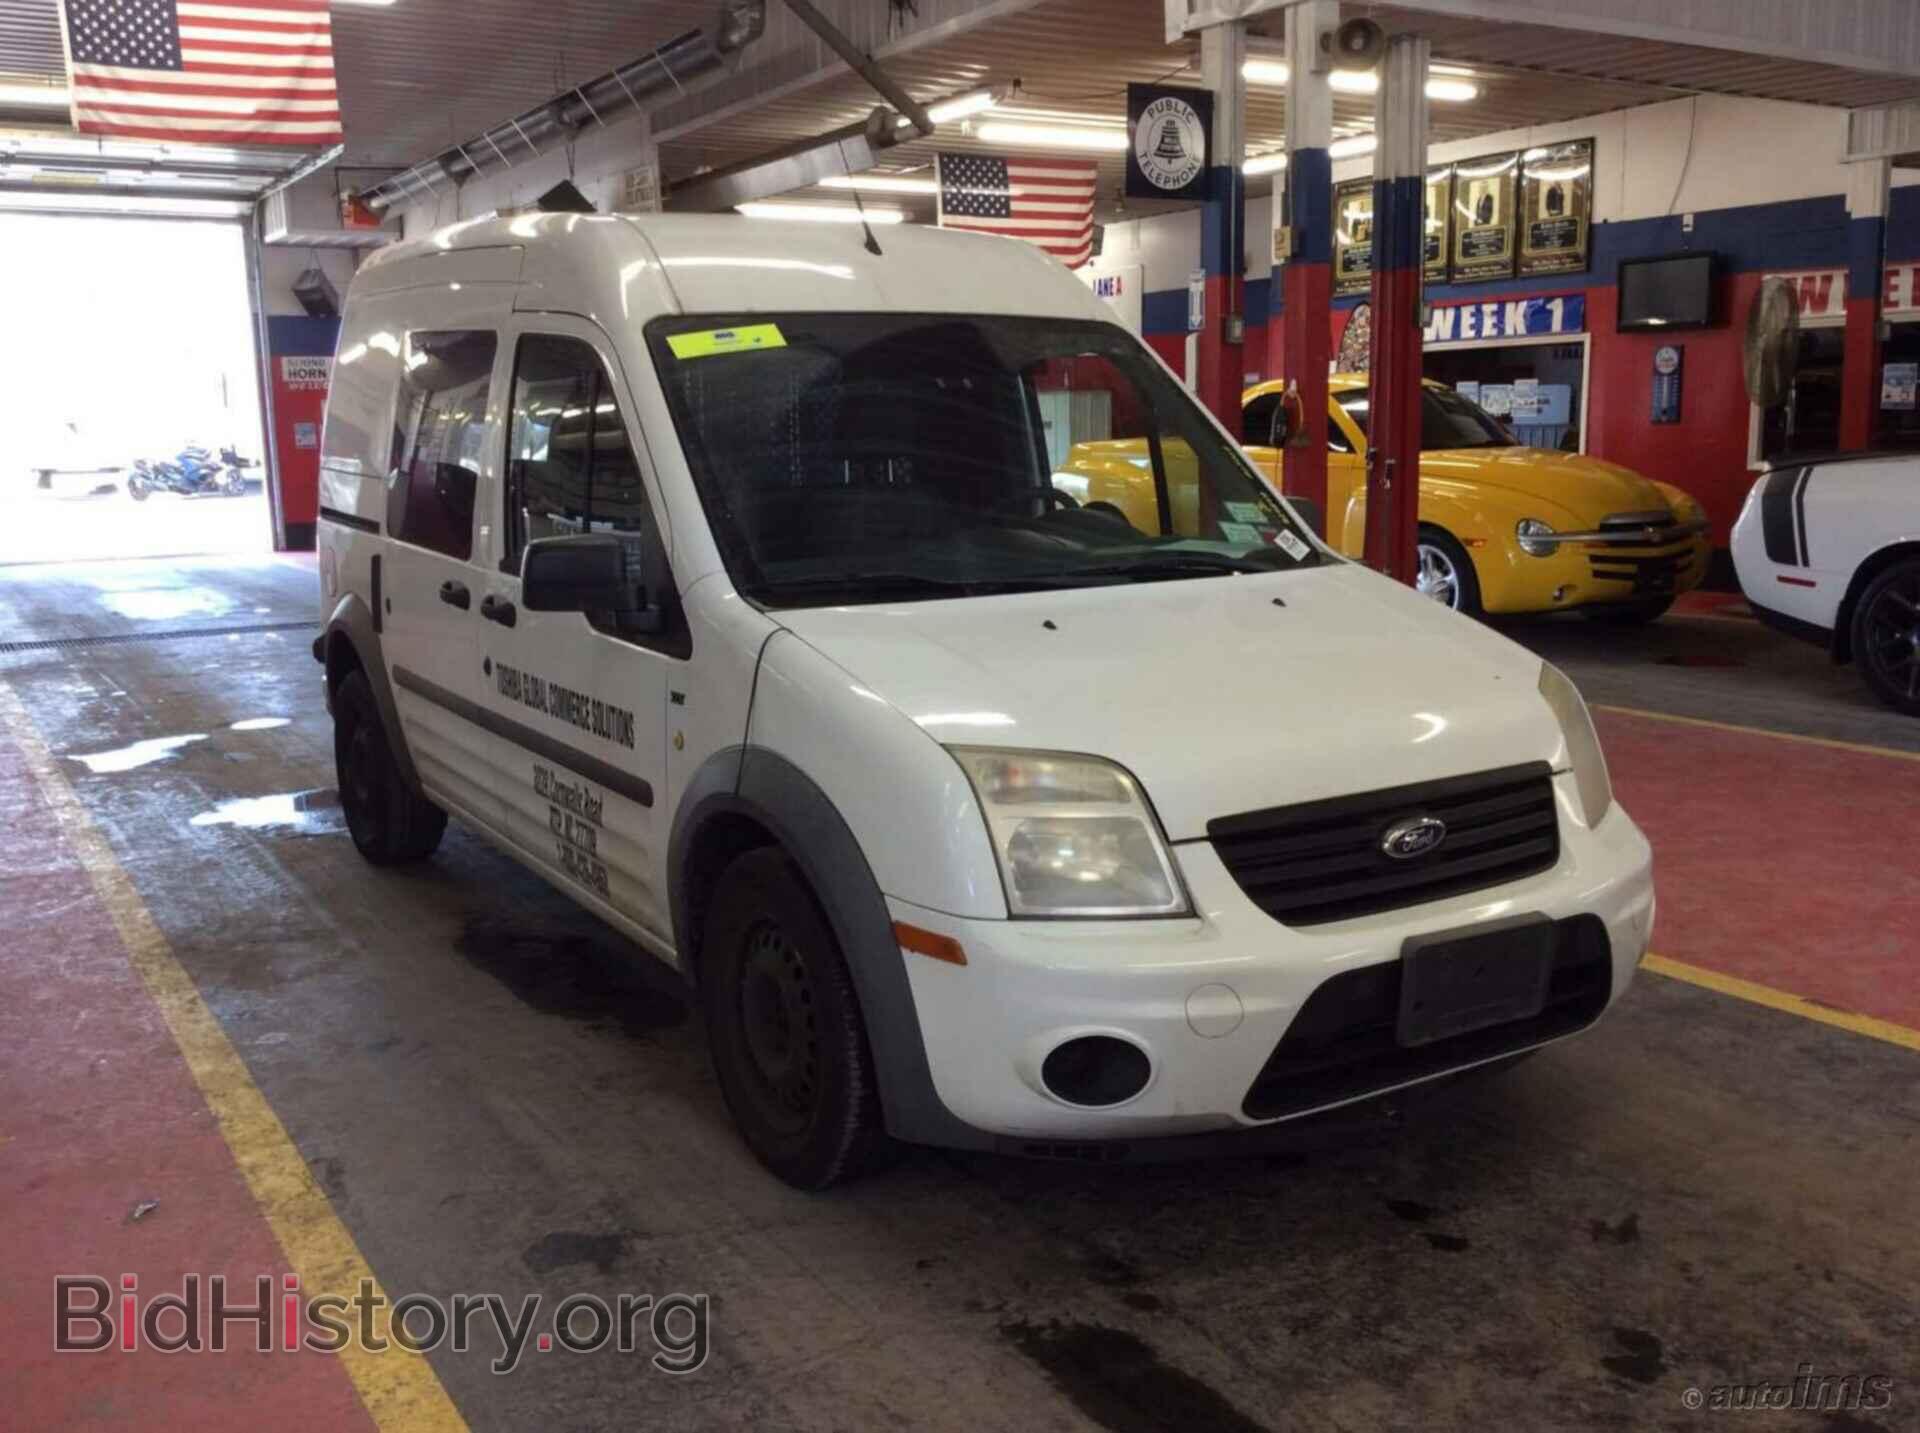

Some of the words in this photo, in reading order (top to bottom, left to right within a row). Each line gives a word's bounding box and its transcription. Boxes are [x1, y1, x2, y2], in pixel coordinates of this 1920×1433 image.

[1147, 98, 1195, 125] PUBLIC
[1139, 150, 1202, 188] TELEPHONE
[1423, 300, 1529, 343] WEEK
[1545, 296, 1565, 334] 1
[287, 368, 328, 380] HORN
